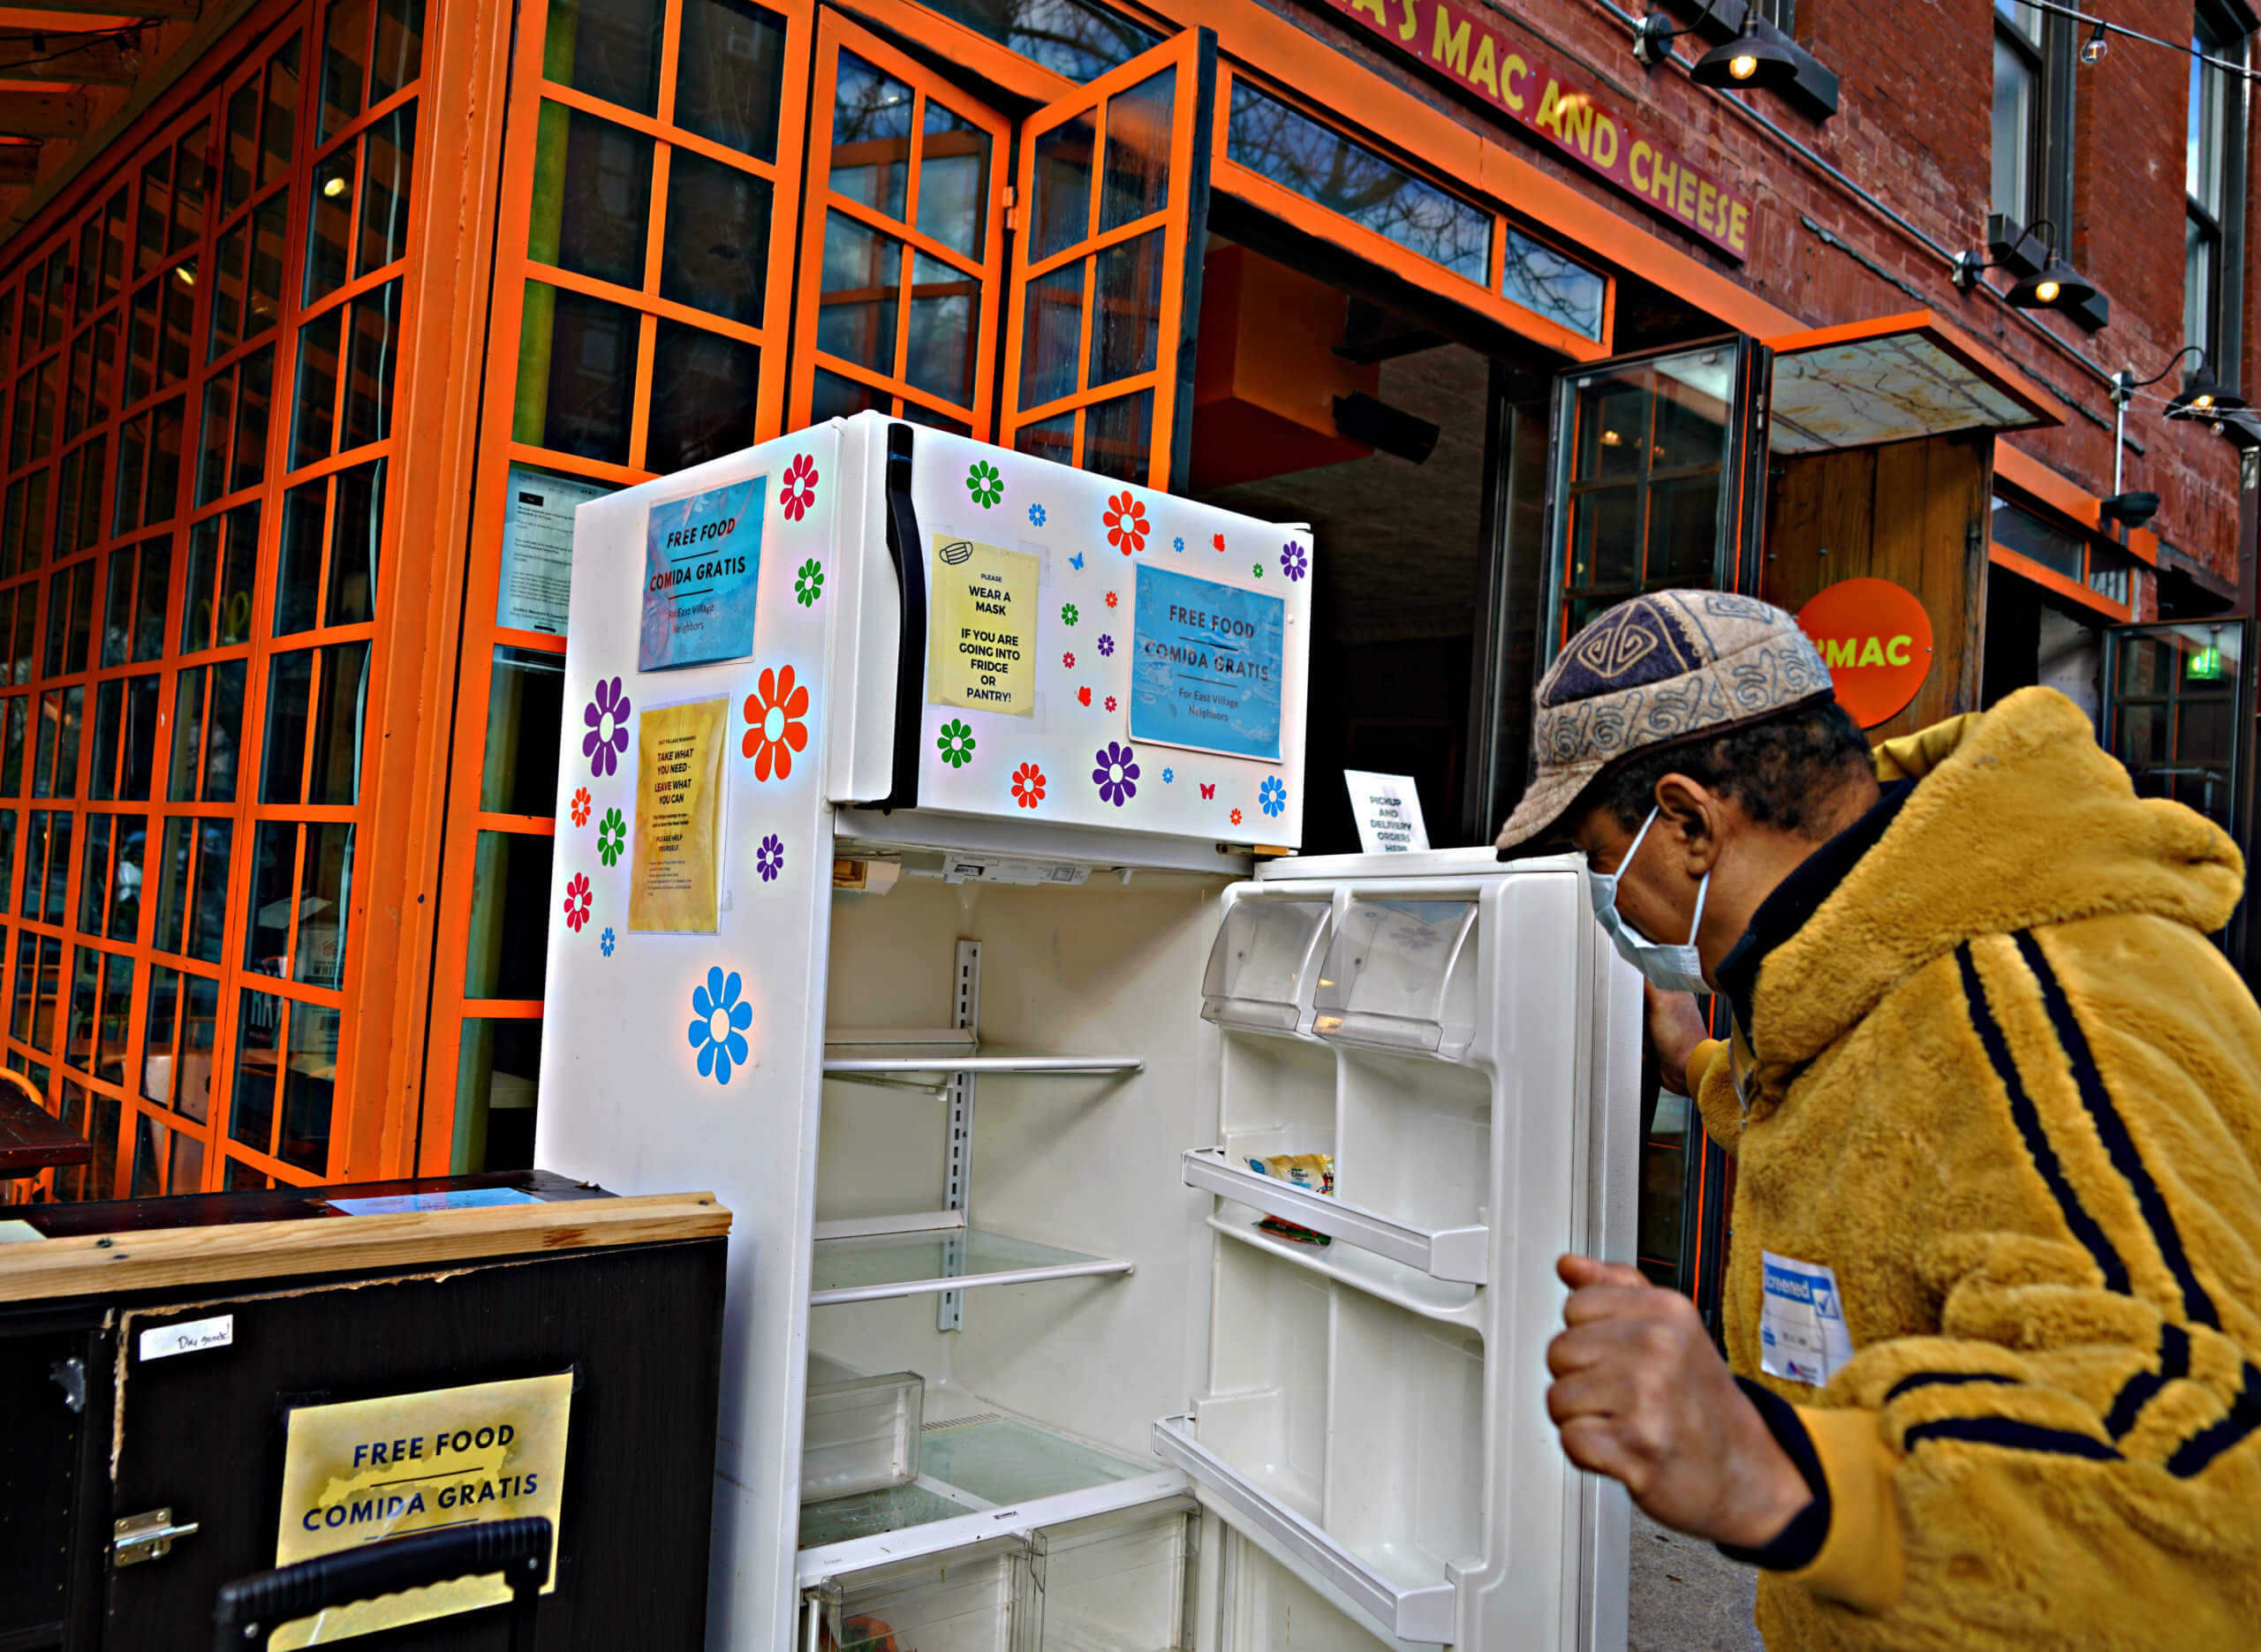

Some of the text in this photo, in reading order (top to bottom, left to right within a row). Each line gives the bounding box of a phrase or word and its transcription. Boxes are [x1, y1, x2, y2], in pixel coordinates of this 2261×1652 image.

[1432, 5, 1527, 111] MAC
[1535, 79, 1618, 170] AND
[1629, 139, 1749, 253] CHEESE
[667, 517, 736, 548] FREE FOOD
[649, 556, 746, 592] COMIDA GRATIS
[980, 573, 1002, 583] PLEASE
[969, 585, 1011, 602] WEAR A
[677, 607, 691, 617] East
[692, 604, 715, 615] Village
[975, 601, 1006, 616] MASK
[672, 622, 704, 634] Neighbors
[1169, 605, 1255, 638] FREE FOOD
[961, 628, 1018, 646] IF YOU ARE
[959, 643, 1020, 660] GOING INTO
[971, 659, 1009, 674] FRIDGE
[1145, 641, 1268, 681] COMIDA GRATIS
[980, 675, 996, 687] OR
[966, 688, 1011, 703] PANTRY!
[1179, 688, 1239, 708] For East Village
[1189, 706, 1229, 721] Neighbors
[657, 748, 694, 762] TAKE WHAT
[657, 765, 669, 775] YOU
[670, 763, 687, 773] NEED
[654, 778, 692, 792] LEAVE WHAT
[659, 793, 684, 805] YOU CAN
[1379, 809, 1399, 818] AND
[1370, 819, 1411, 831] DELIVERY
[1377, 832, 1411, 842] ORDERS
[353, 1424, 515, 1468] FREE FOOD
[302, 1473, 538, 1532] COMIDA GRATIS
